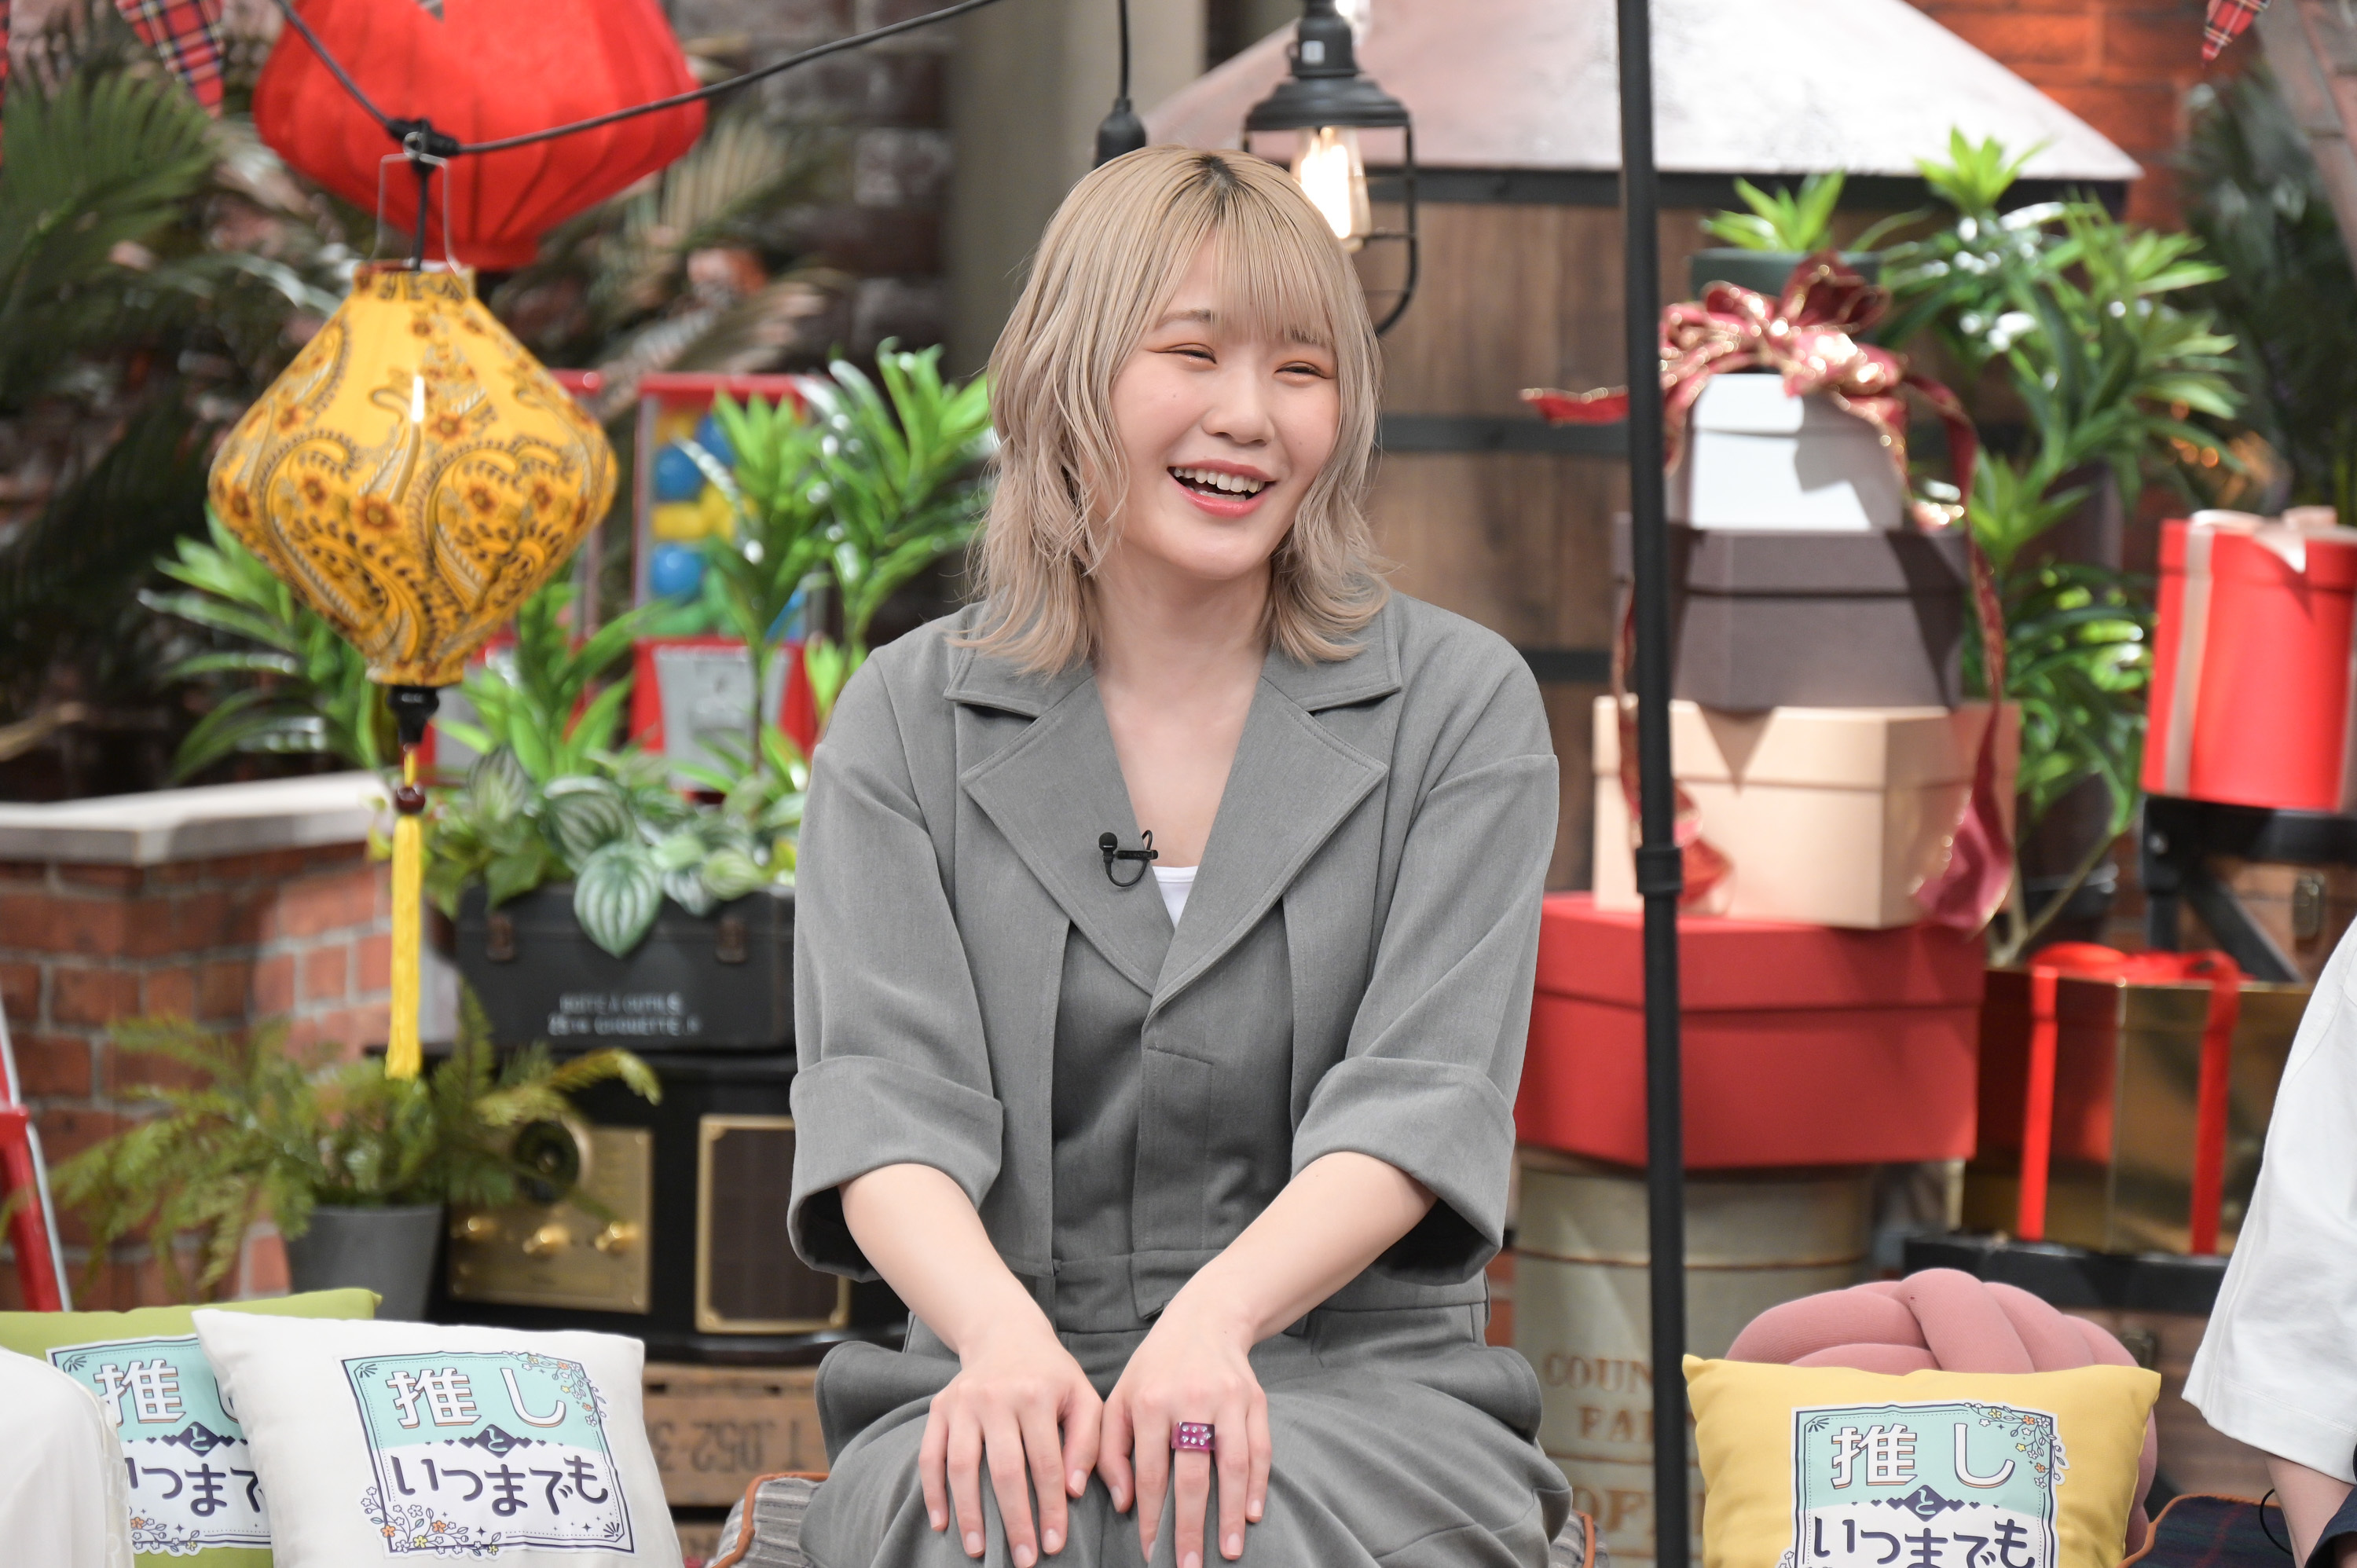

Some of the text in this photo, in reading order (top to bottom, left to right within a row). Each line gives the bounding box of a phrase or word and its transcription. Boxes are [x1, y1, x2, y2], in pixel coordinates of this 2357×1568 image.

[1542, 1352, 1655, 1395] COUN
[385, 1368, 566, 1429] 推し
[189, 1426, 211, 1452] と
[486, 1427, 509, 1454] と
[1831, 1423, 2015, 1489] 推し
[390, 1455, 608, 1517] いつまでも
[1915, 1489, 1937, 1515] と
[1814, 1516, 2036, 1568] いつまでも
